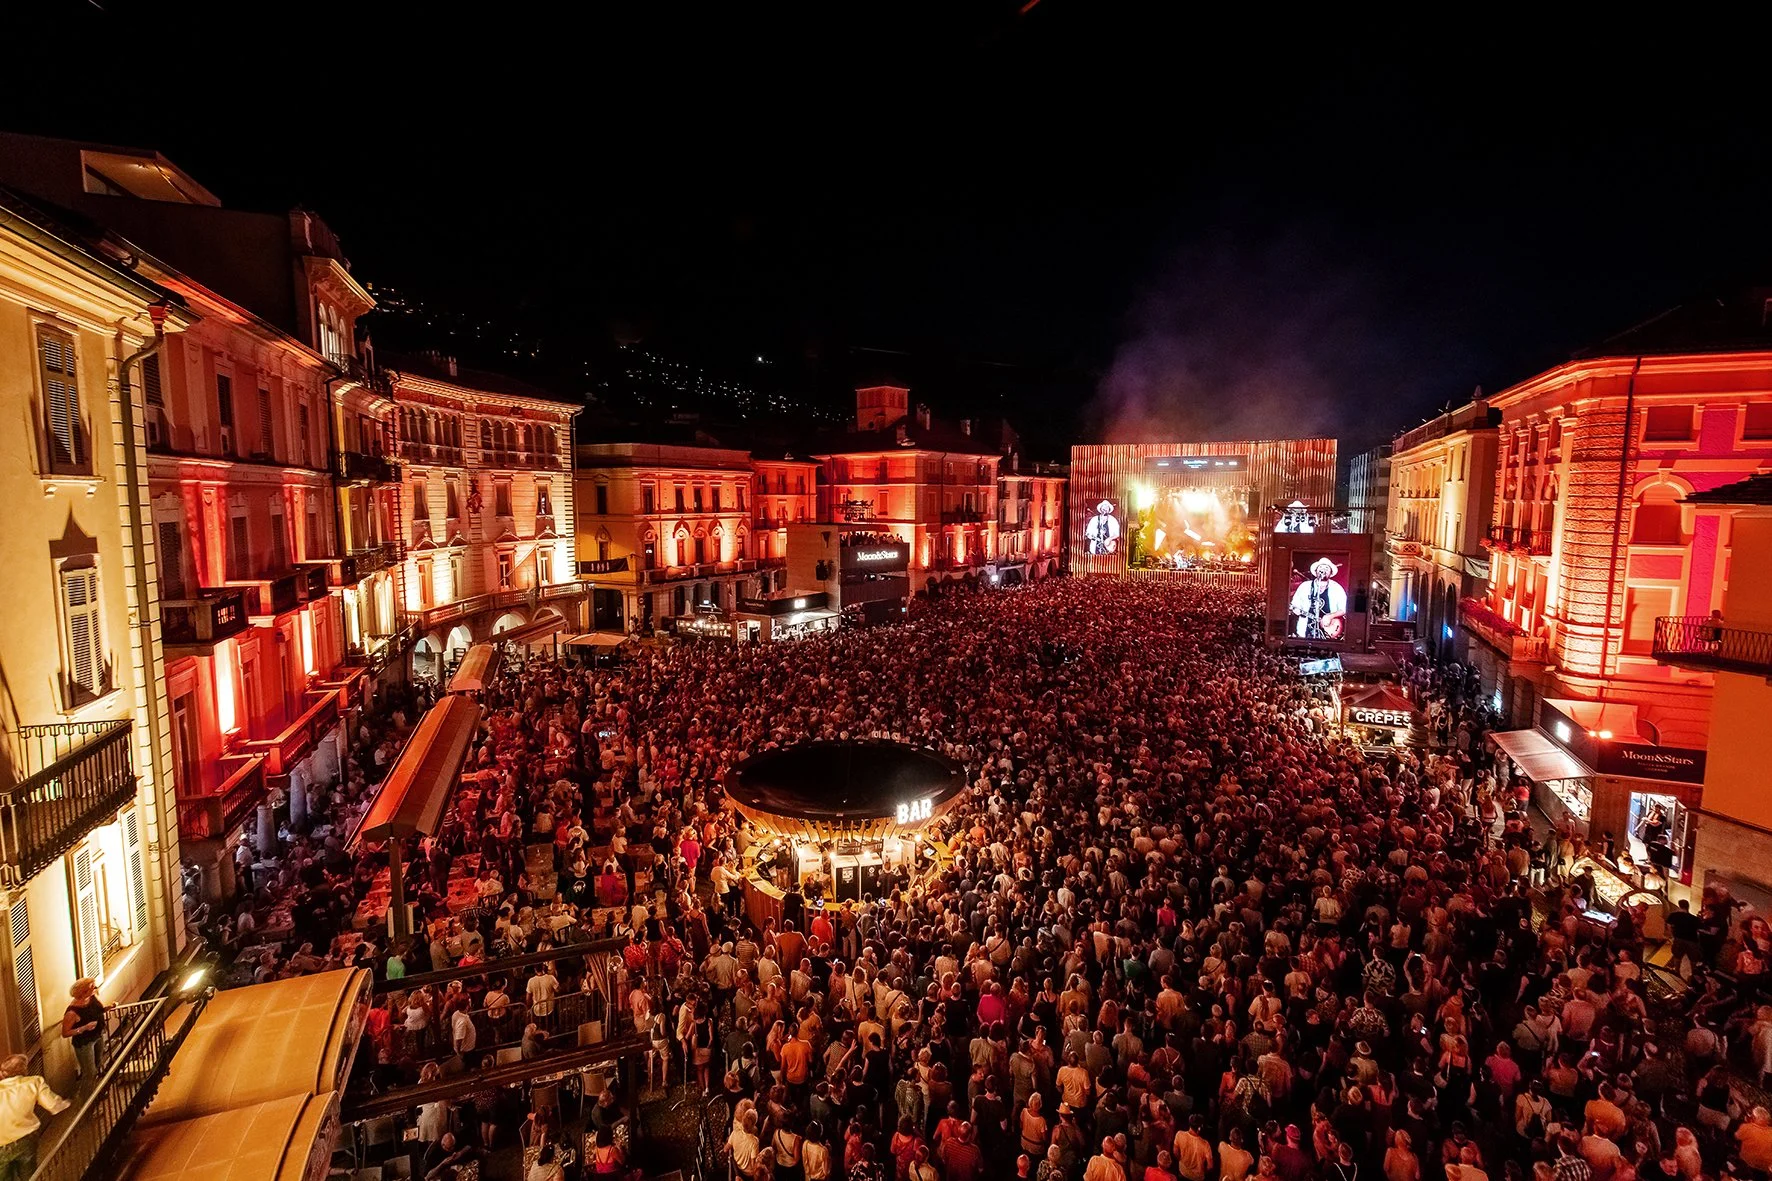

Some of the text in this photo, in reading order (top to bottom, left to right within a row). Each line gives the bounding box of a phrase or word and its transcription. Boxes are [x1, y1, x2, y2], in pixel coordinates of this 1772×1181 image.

[1355, 711, 1411, 727] CRÊPES
[1622, 750, 1694, 765] Moon&Stars
[897, 799, 932, 824] BAR
